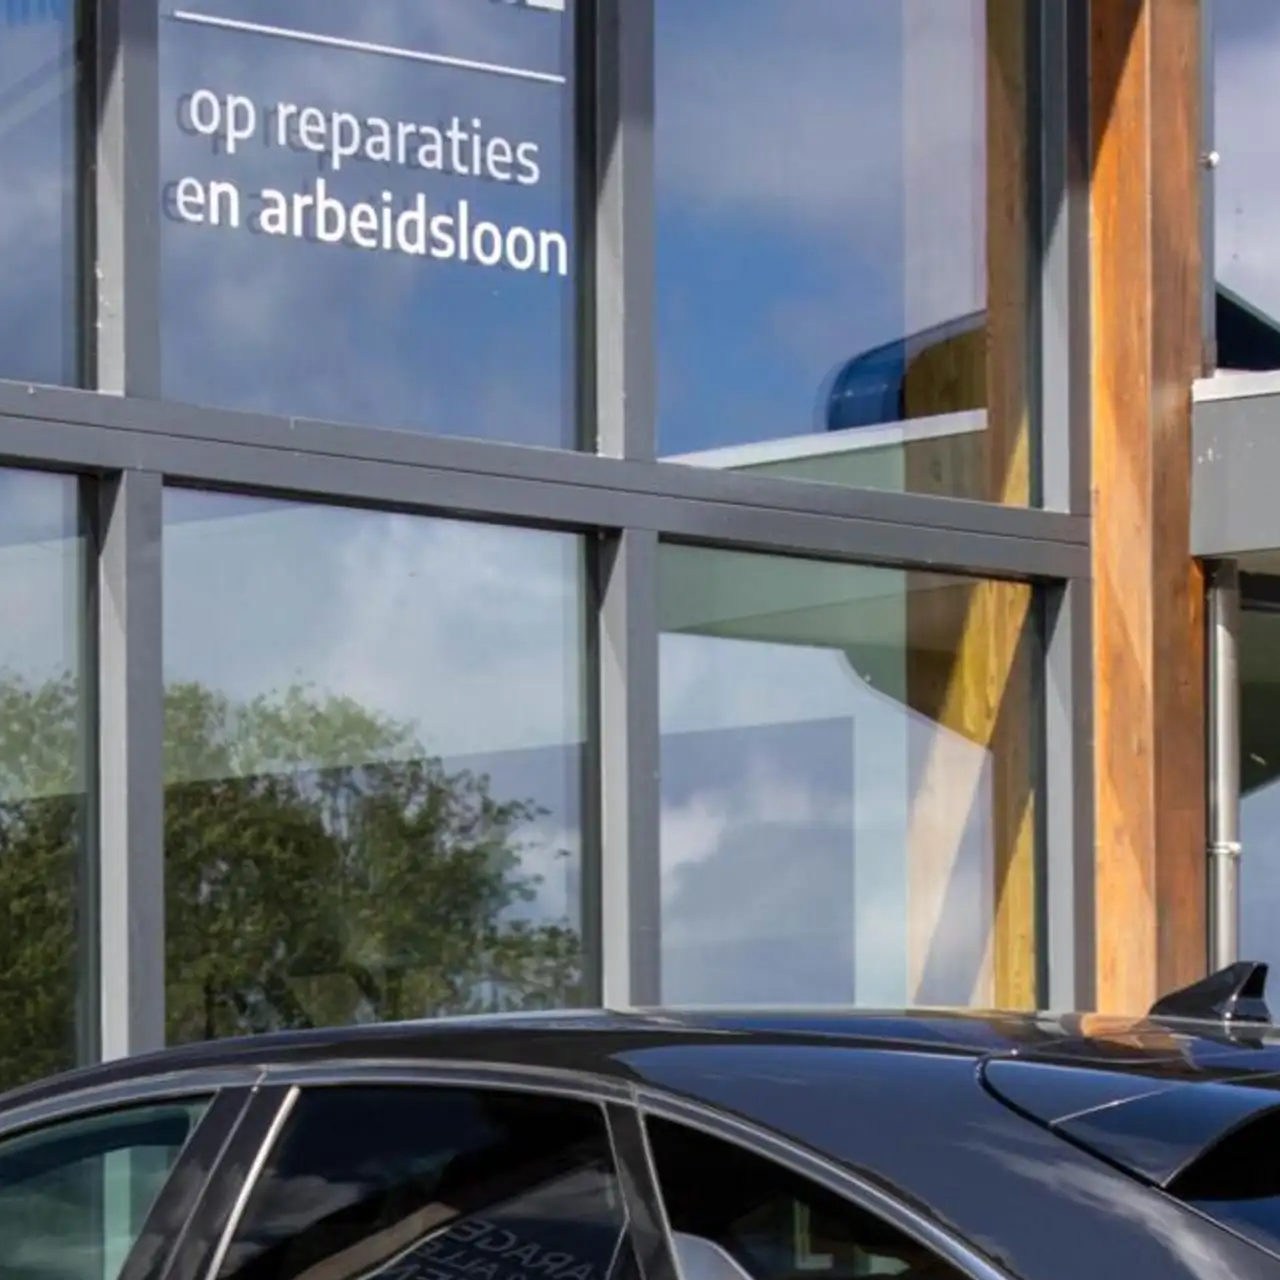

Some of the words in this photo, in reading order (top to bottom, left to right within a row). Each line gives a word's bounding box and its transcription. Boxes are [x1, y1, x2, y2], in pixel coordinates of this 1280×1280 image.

[188, 88, 257, 154] op
[276, 101, 541, 186] reparaties
[176, 173, 239, 229] en
[260, 179, 569, 276] arbeidsloon
